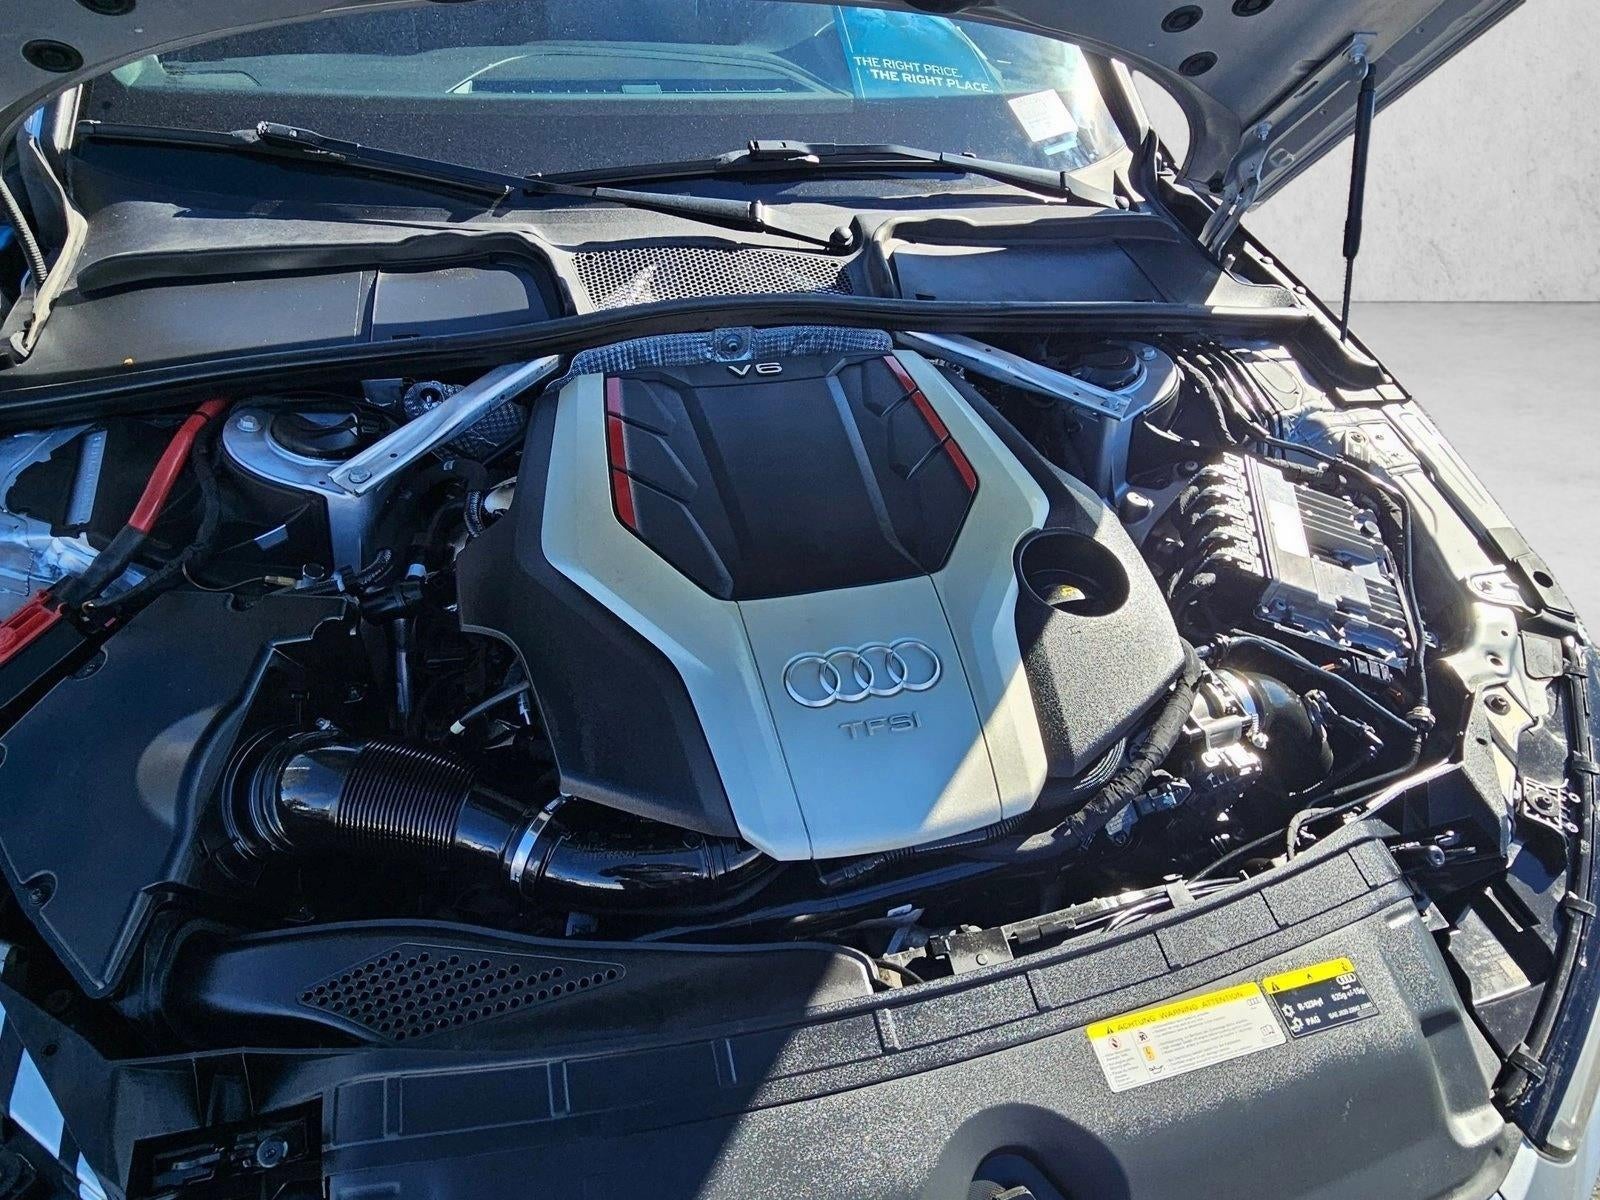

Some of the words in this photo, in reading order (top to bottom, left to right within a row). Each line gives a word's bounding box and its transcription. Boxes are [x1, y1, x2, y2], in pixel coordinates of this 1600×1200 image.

[853, 56, 881, 68] THE
[883, 58, 921, 73] RIGHT
[923, 64, 963, 78] PRICE.
[870, 69, 900, 81] THE
[902, 73, 943, 87] RIGHT
[946, 78, 994, 93] PLACE.
[728, 362, 783, 376] V6
[838, 712, 921, 739] TFSI
[1117, 1013, 1156, 1031] ACHTUNG
[1159, 1003, 1199, 1020] WARNING
[1201, 991, 1244, 1008] ATTENTION
[1305, 1015, 1322, 1026] PAG
